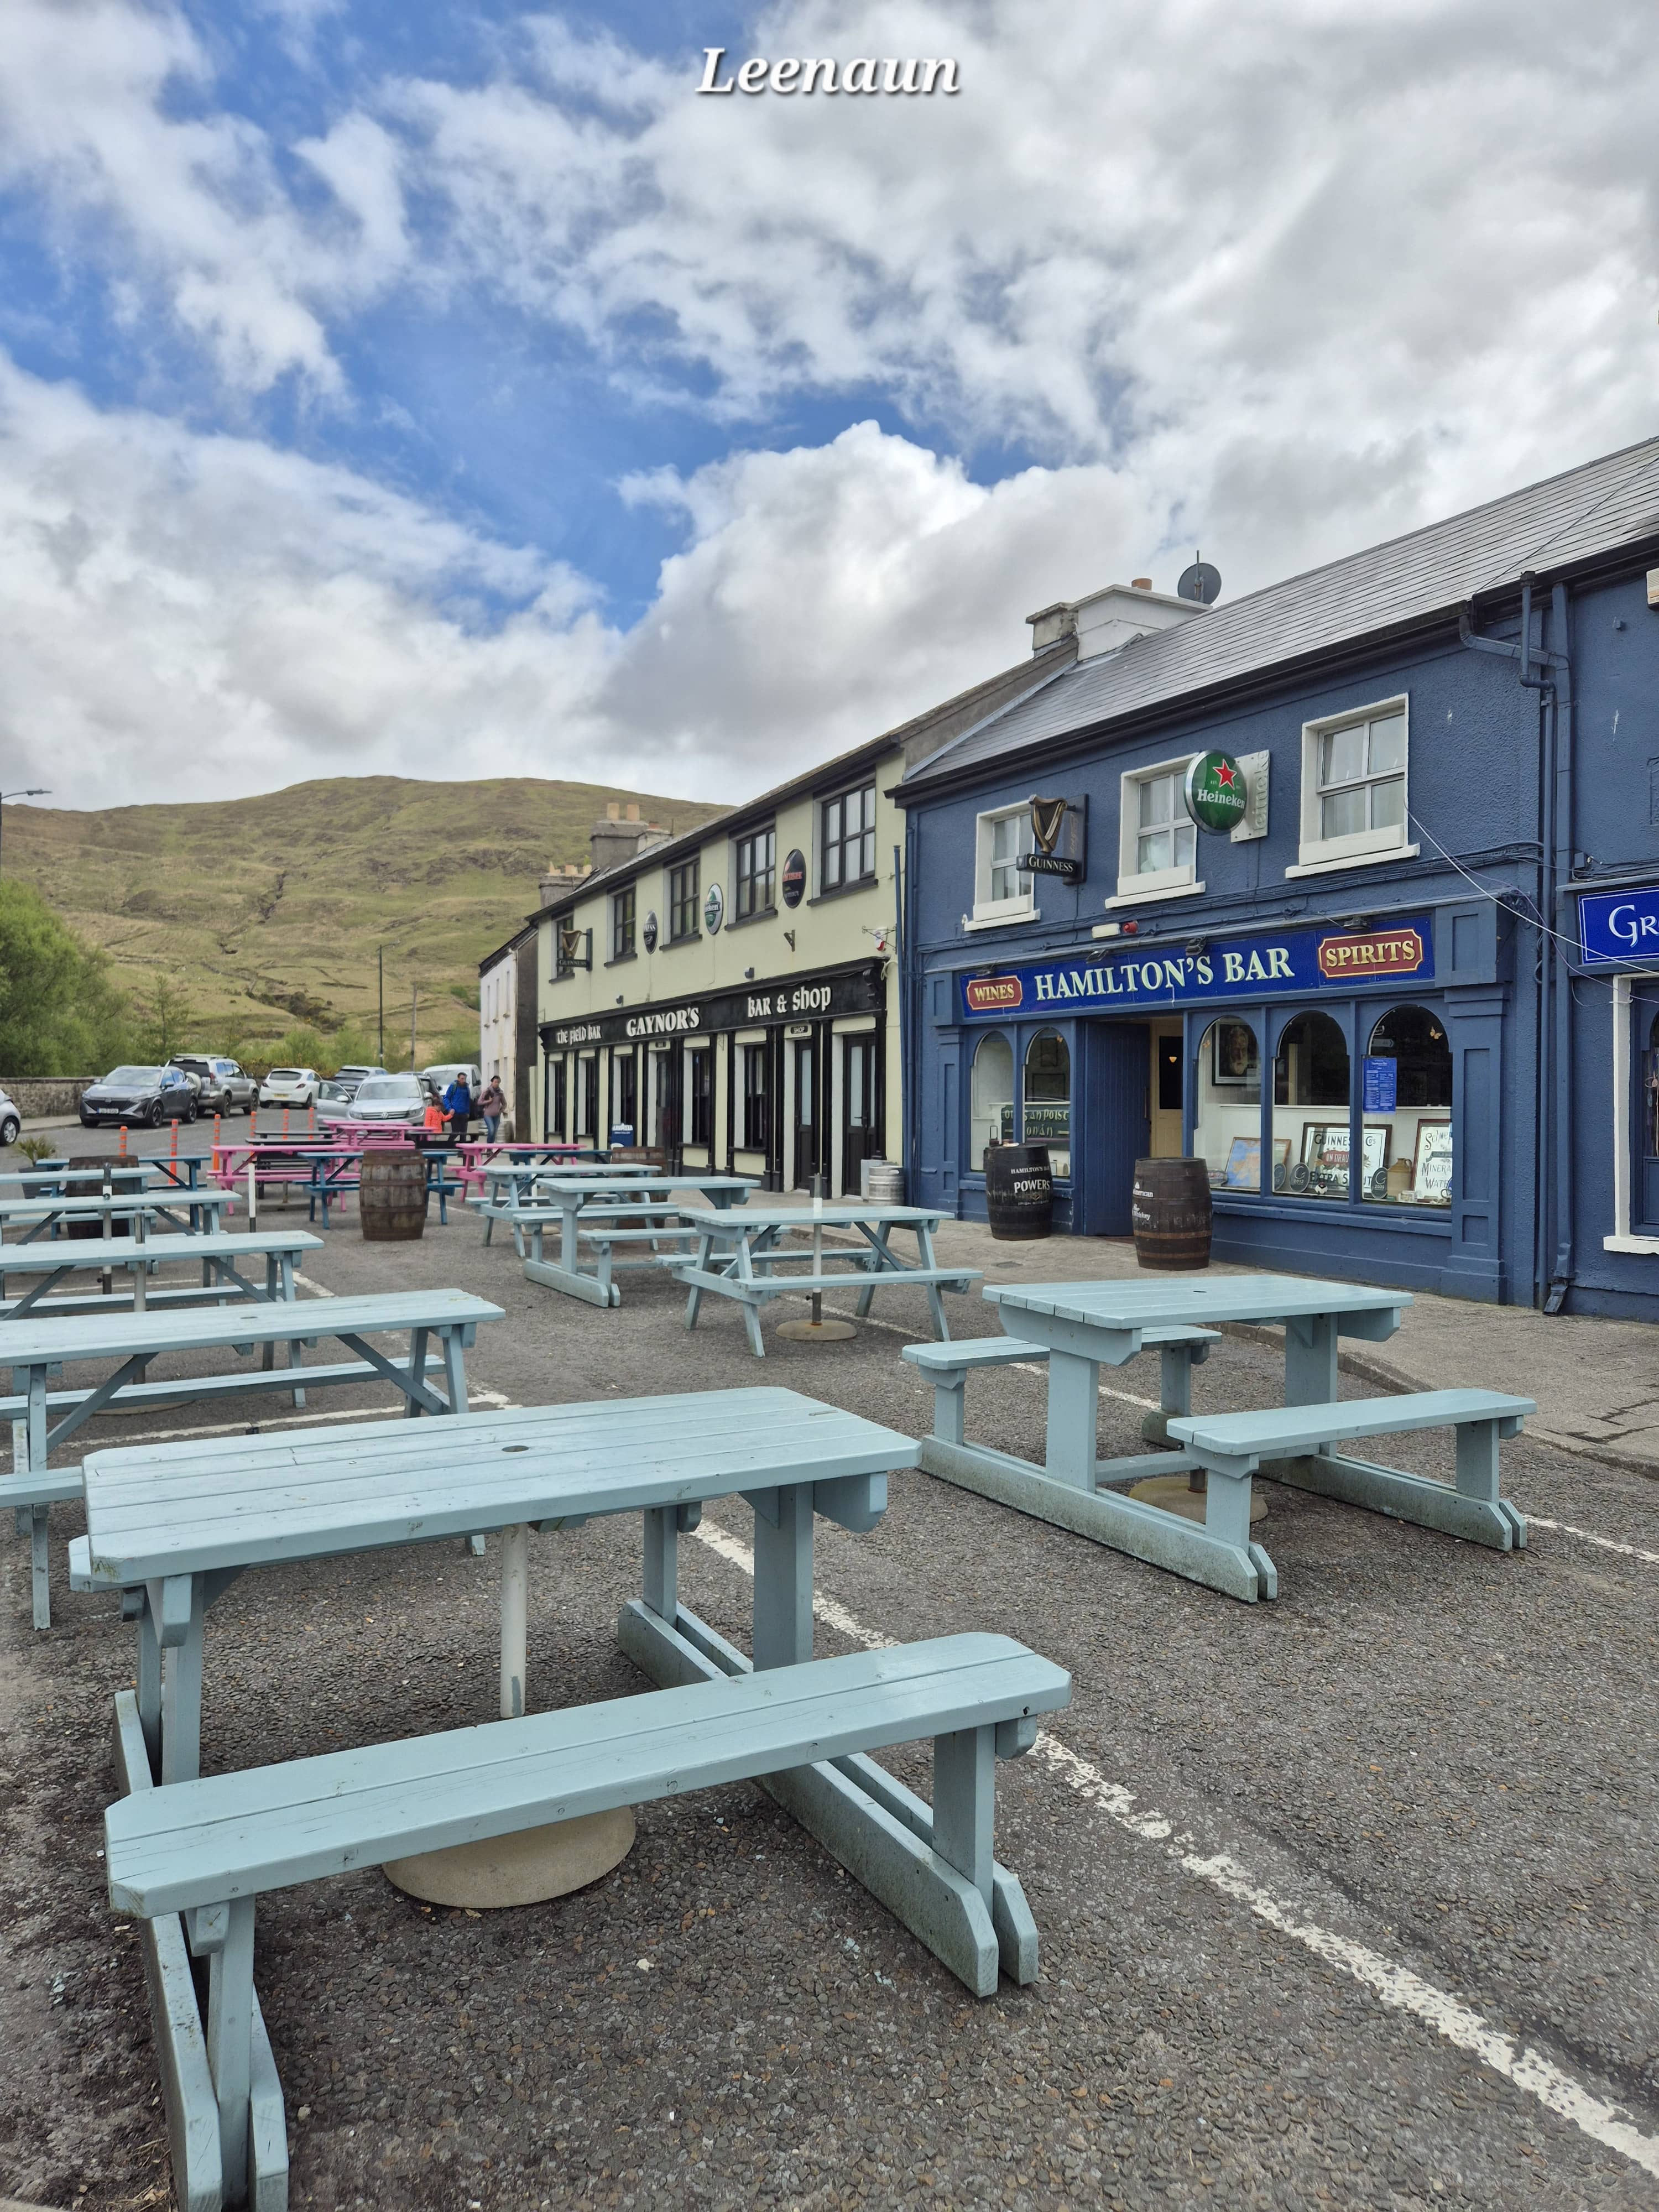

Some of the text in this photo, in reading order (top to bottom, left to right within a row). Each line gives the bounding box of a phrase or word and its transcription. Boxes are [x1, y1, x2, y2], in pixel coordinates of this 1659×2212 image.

[1197, 789, 1245, 809] Heineken
[1029, 855, 1073, 873] GUINNESS
[1609, 904, 1659, 948] GR
[1326, 940, 1415, 967] SPIRITS
[1035, 947, 1295, 1000] HAMILTON'S BAR
[974, 984, 1015, 1001] WINES
[776, 994, 787, 1013] &
[626, 1008, 700, 1037] GAYNOR'S
[1334, 1154, 1349, 1162] DRAU
[1422, 1162, 1451, 1176] MINERA
[1014, 1179, 1050, 1193] POWERS
